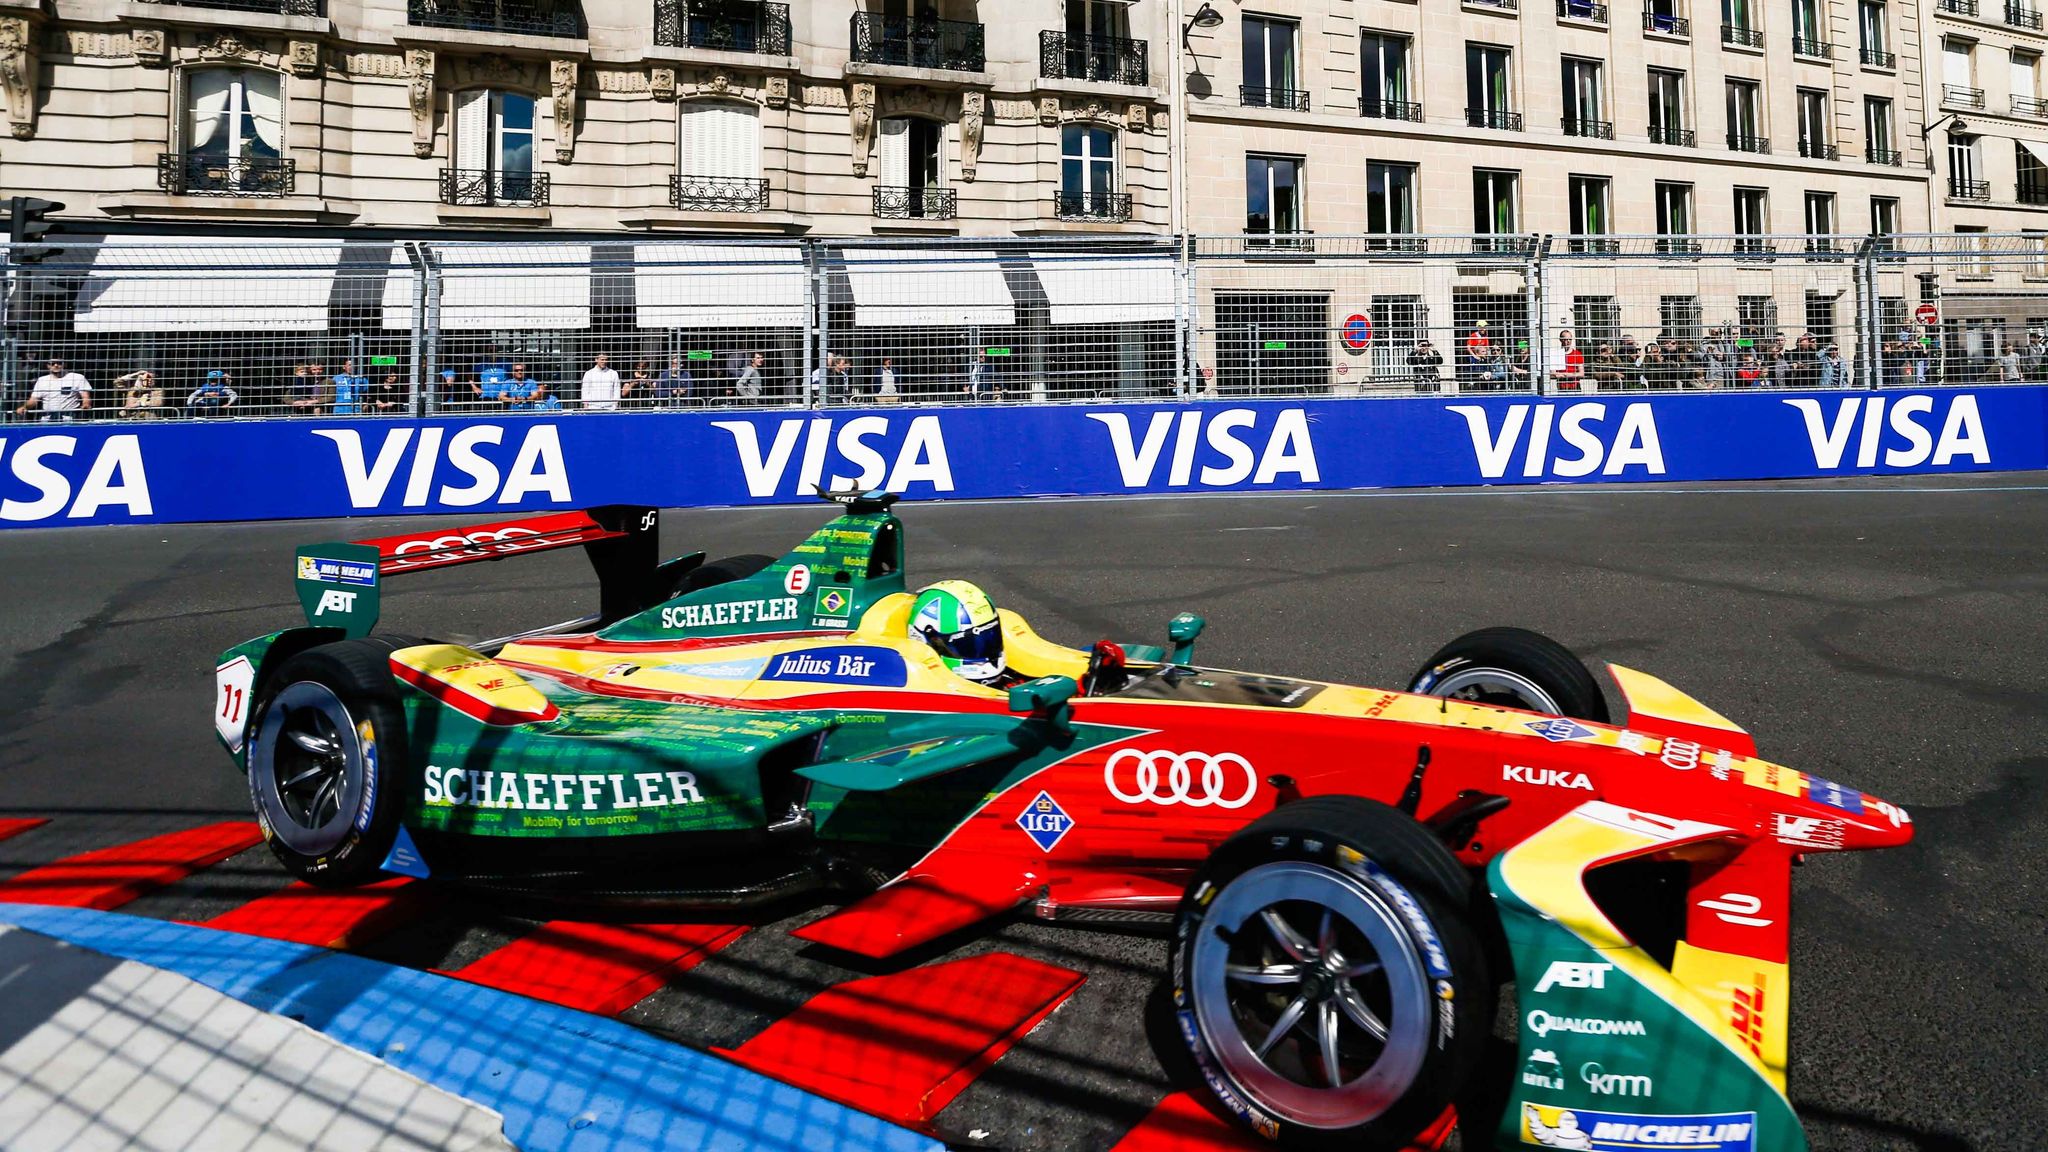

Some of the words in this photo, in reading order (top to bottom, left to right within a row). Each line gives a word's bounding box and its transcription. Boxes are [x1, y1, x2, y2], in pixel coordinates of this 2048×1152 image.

[1086, 408, 1321, 488] VISA
[1445, 402, 1666, 478] VISA
[1782, 394, 1991, 469] VISA
[311, 425, 573, 508] VISA
[710, 415, 955, 497] VISA
[0, 435, 154, 521] SA
[320, 564, 374, 578] MICHELIN
[314, 589, 357, 616] ABT
[661, 597, 798, 629] SCHAEFFLER
[773, 654, 831, 677] Julius
[834, 654, 876, 677] Bär
[222, 682, 242, 724] 11
[1363, 694, 1400, 717] DHL
[358, 757, 375, 832] MICHELIN
[424, 765, 705, 811] SCHAEFFLER
[1502, 764, 1595, 791] KUKA
[523, 814, 563, 829] Mobility
[566, 815, 582, 827] for
[585, 814, 638, 826] tomorrow
[1025, 813, 1065, 832] LGT
[1533, 961, 1614, 993] ABT
[1731, 987, 1764, 1058] HL
[1591, 1121, 1752, 1144] MICHELIN
